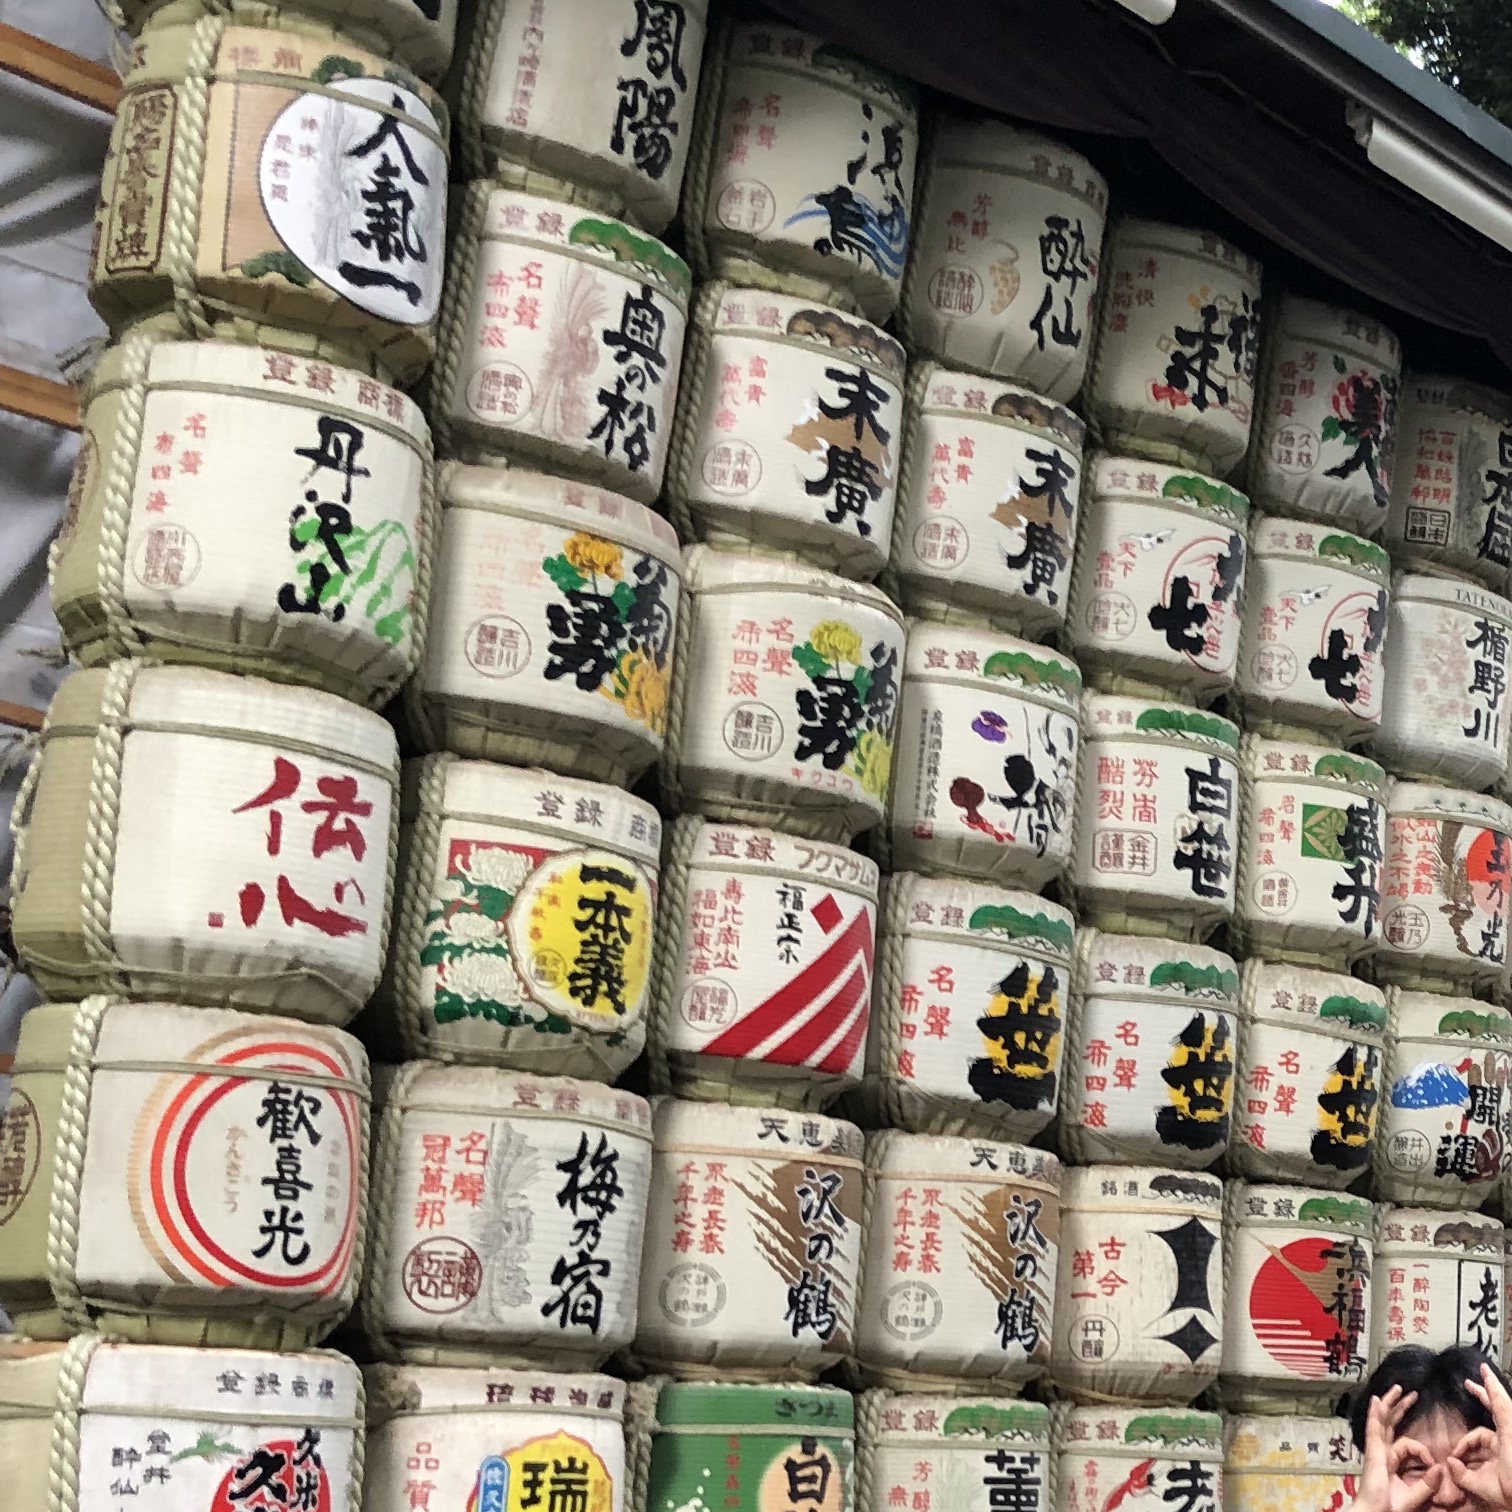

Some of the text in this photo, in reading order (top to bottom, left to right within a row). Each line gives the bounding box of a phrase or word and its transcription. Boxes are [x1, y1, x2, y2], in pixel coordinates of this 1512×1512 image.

[588, 285, 667, 471] 奥の松
[278, 416, 372, 622] 丹沢山
[232, 756, 373, 937] 伝心
[1479, 831, 1509, 964] 玉乃光
[567, 864, 637, 1015] 一本義
[926, 965, 955, 1041] 名聲
[1112, 1020, 1141, 1092] 名聲
[1273, 1050, 1302, 1116] 名聲
[540, 1130, 625, 1335] 梅乃宿
[784, 1166, 847, 1341] 沢の鶴
[994, 1194, 1049, 1354] 沢の鶴
[1071, 1250, 1098, 1299] 第一
[1097, 1236, 1129, 1298] 古今
